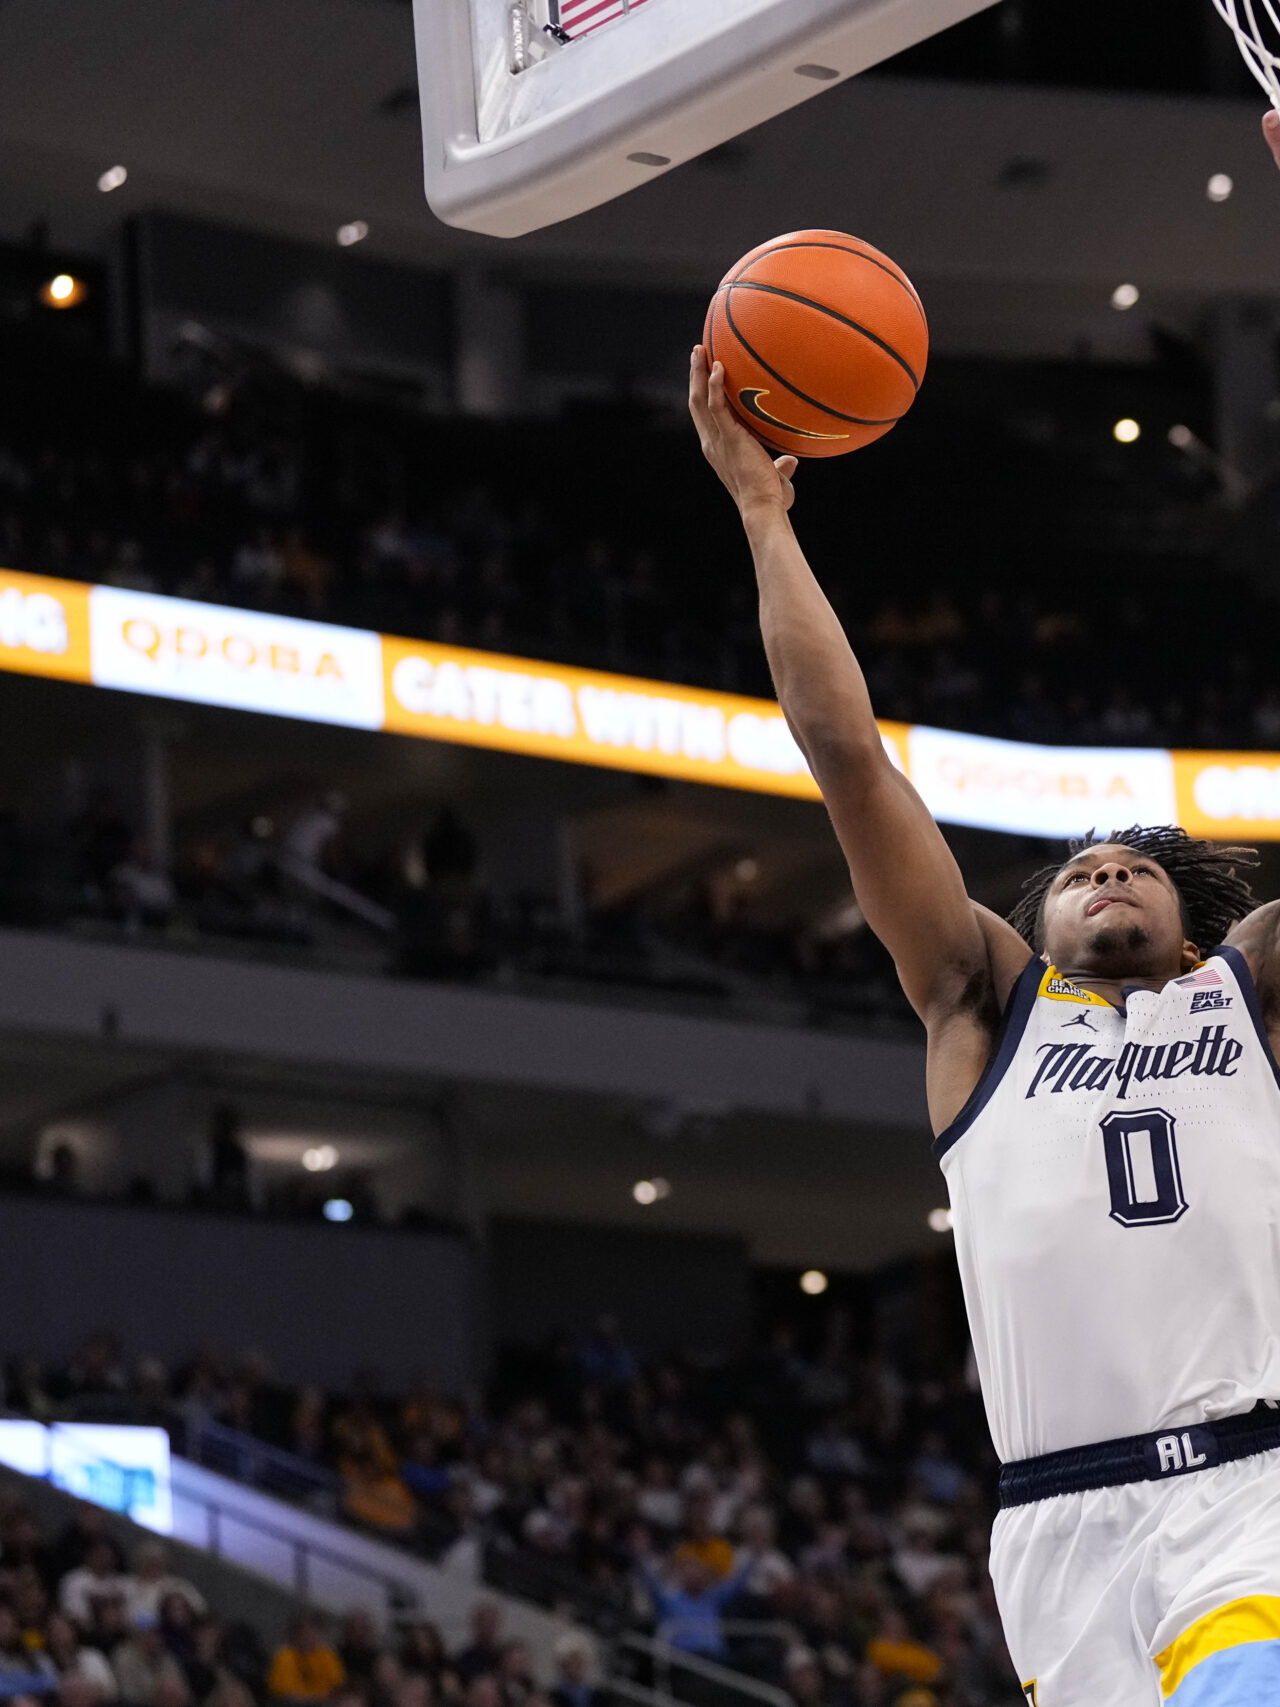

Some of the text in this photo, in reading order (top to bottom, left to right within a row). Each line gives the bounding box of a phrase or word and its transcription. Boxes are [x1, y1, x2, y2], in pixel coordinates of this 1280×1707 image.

[121, 618, 345, 680] QDOBA
[393, 656, 577, 738] CATER
[1190, 997, 1234, 1010] EAST
[1192, 989, 1223, 1002] BIG
[1099, 1107, 1190, 1228] 0
[1155, 1432, 1207, 1472] AL
